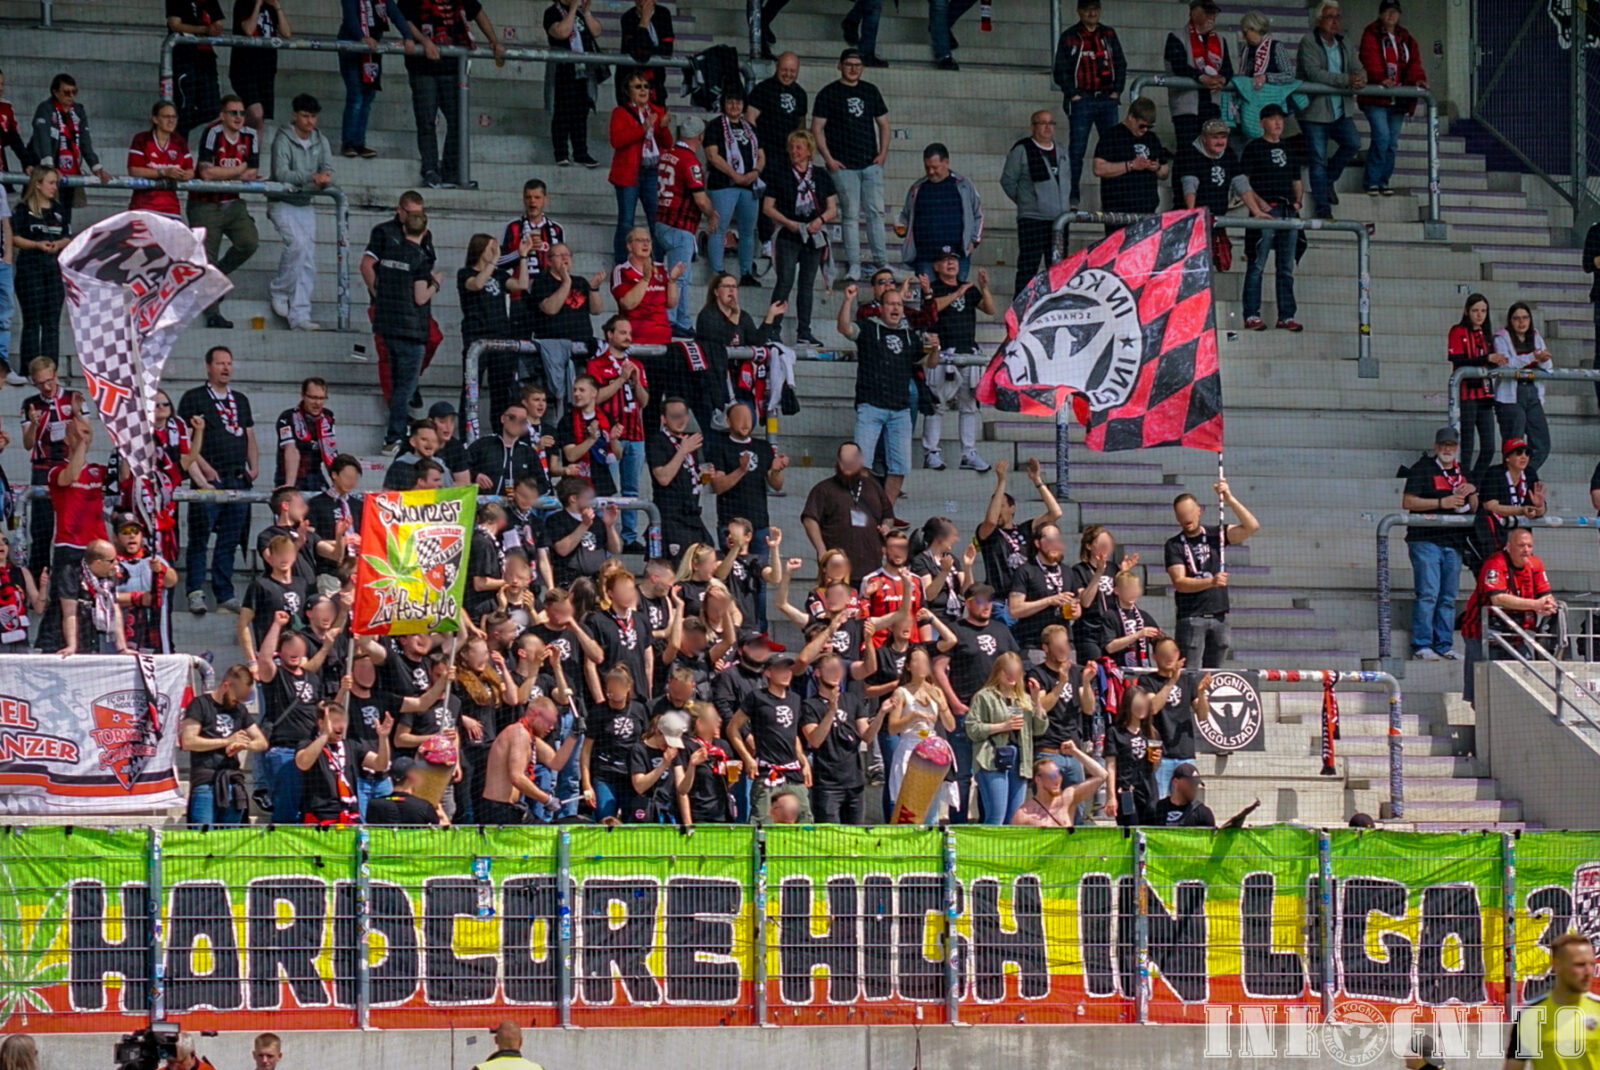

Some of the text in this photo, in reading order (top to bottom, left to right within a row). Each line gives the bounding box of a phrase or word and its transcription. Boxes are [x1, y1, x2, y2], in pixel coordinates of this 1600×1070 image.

[376, 494, 461, 525] Schanzer
[368, 587, 457, 630] Lifestyle
[0, 699, 36, 728] EL
[1198, 718, 1257, 746] INGOLSTADT
[67, 877, 743, 1013] HARDCORE
[780, 873, 1050, 1004] HIGH
[1080, 872, 1210, 1004] IN
[1240, 871, 1488, 1007] LIGA
